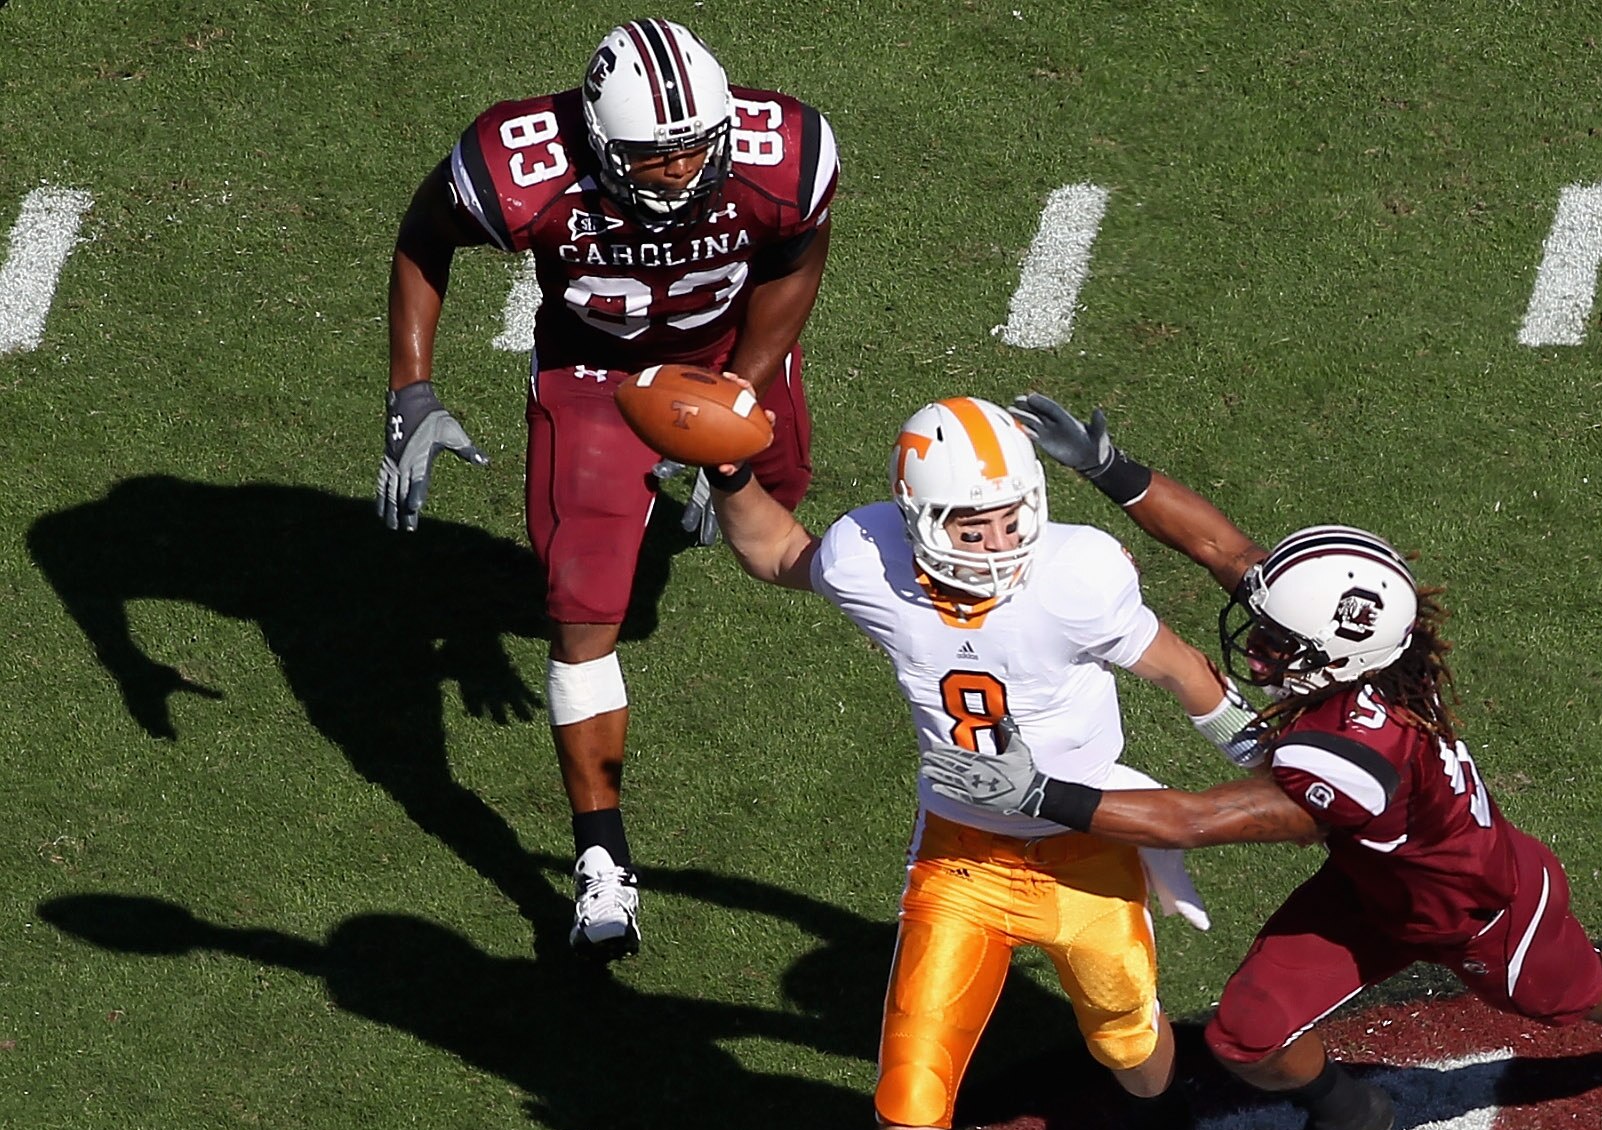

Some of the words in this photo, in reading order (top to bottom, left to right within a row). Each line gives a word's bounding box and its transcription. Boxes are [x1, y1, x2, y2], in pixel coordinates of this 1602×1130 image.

[499, 110, 569, 188] 83
[729, 98, 785, 166] 83
[558, 229, 752, 267] CAROLINA
[938, 668, 1011, 757] 8
